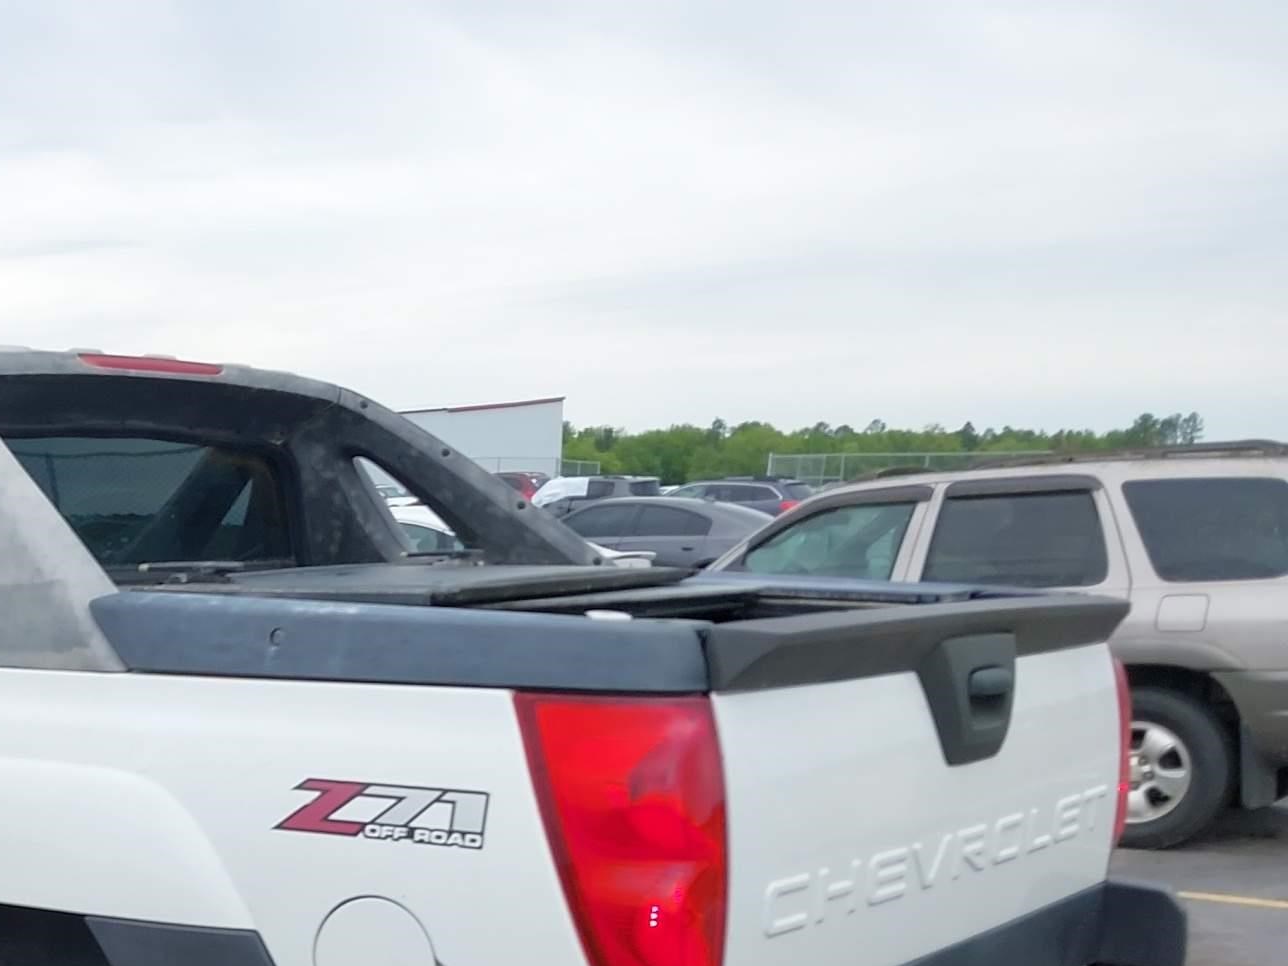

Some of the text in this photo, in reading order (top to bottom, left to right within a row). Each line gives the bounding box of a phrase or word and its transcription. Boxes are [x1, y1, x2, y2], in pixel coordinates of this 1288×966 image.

[272, 777, 490, 848] Z71
[362, 823, 484, 850] OFF ROAD
[764, 784, 1109, 939] CHEVROLET
